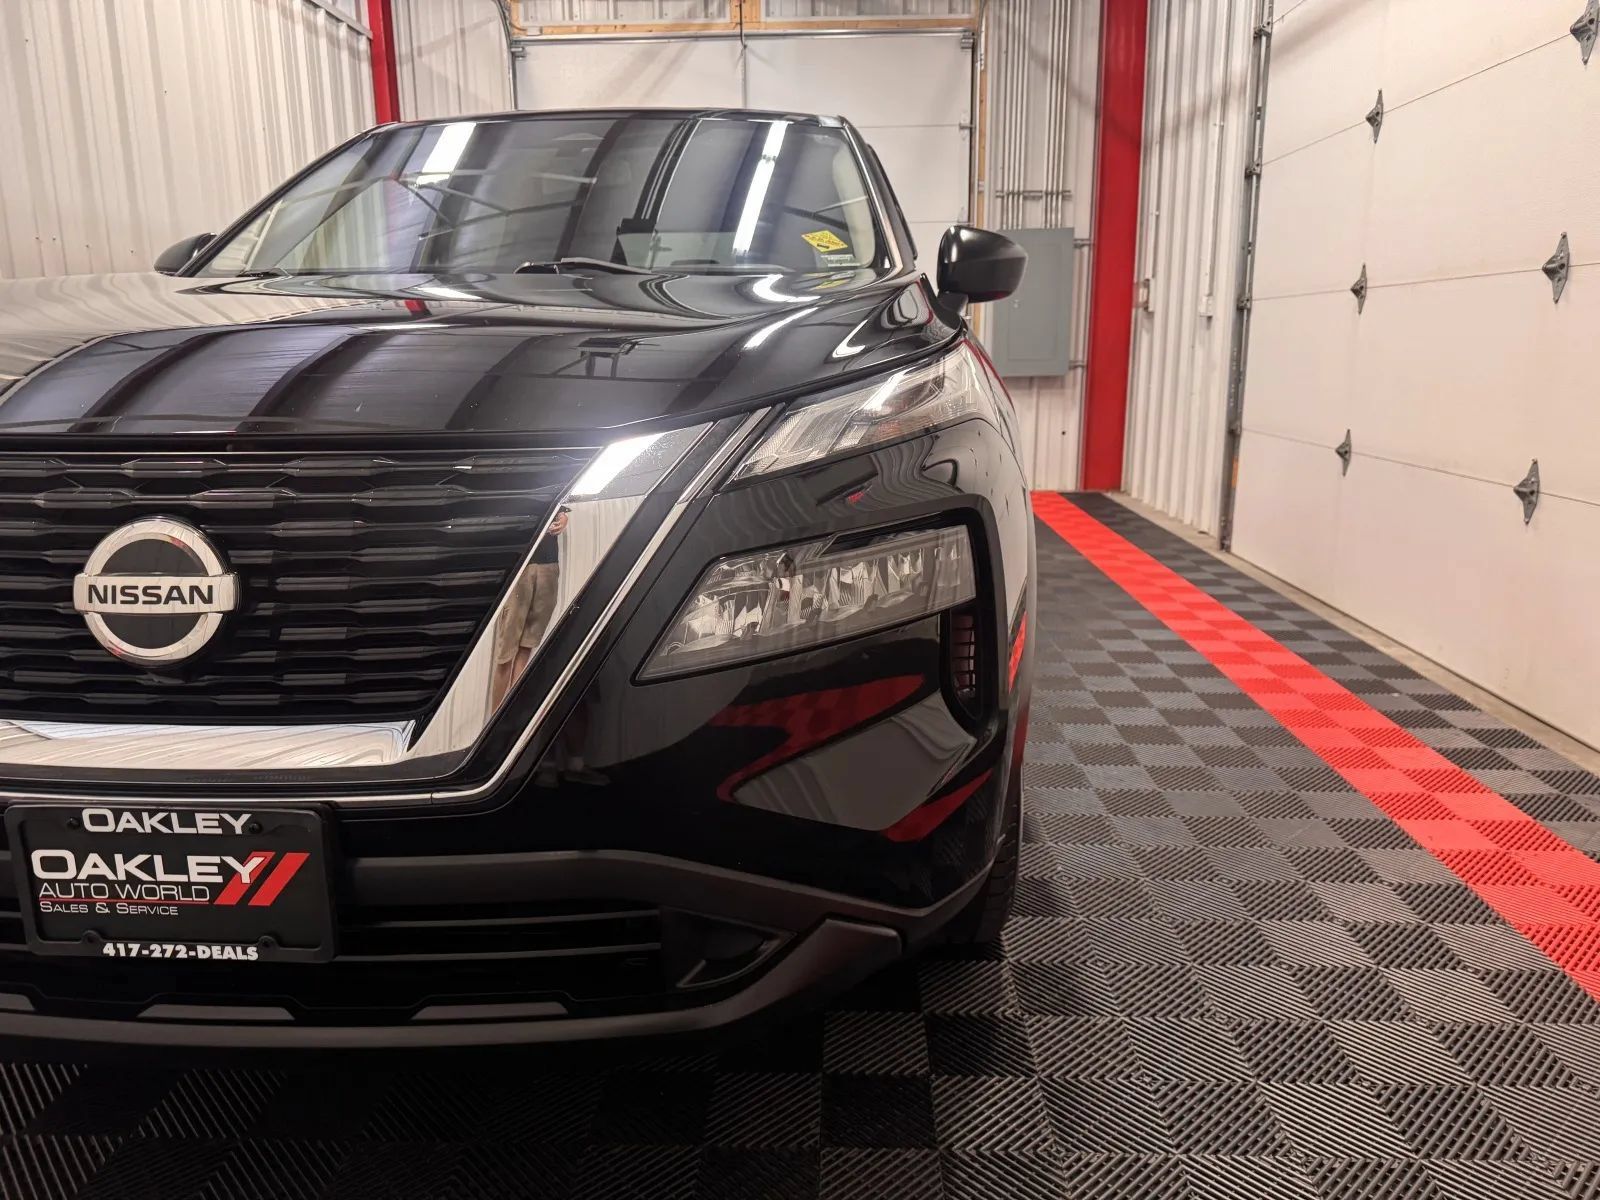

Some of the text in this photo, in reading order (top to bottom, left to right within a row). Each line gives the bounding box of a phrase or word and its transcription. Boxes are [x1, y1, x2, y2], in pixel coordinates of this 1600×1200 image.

[88, 584, 213, 605] NISSAN
[39, 882, 210, 901] AUTO WORLD
[95, 902, 111, 914] &
[102, 942, 259, 961] 417-272-DEALS
